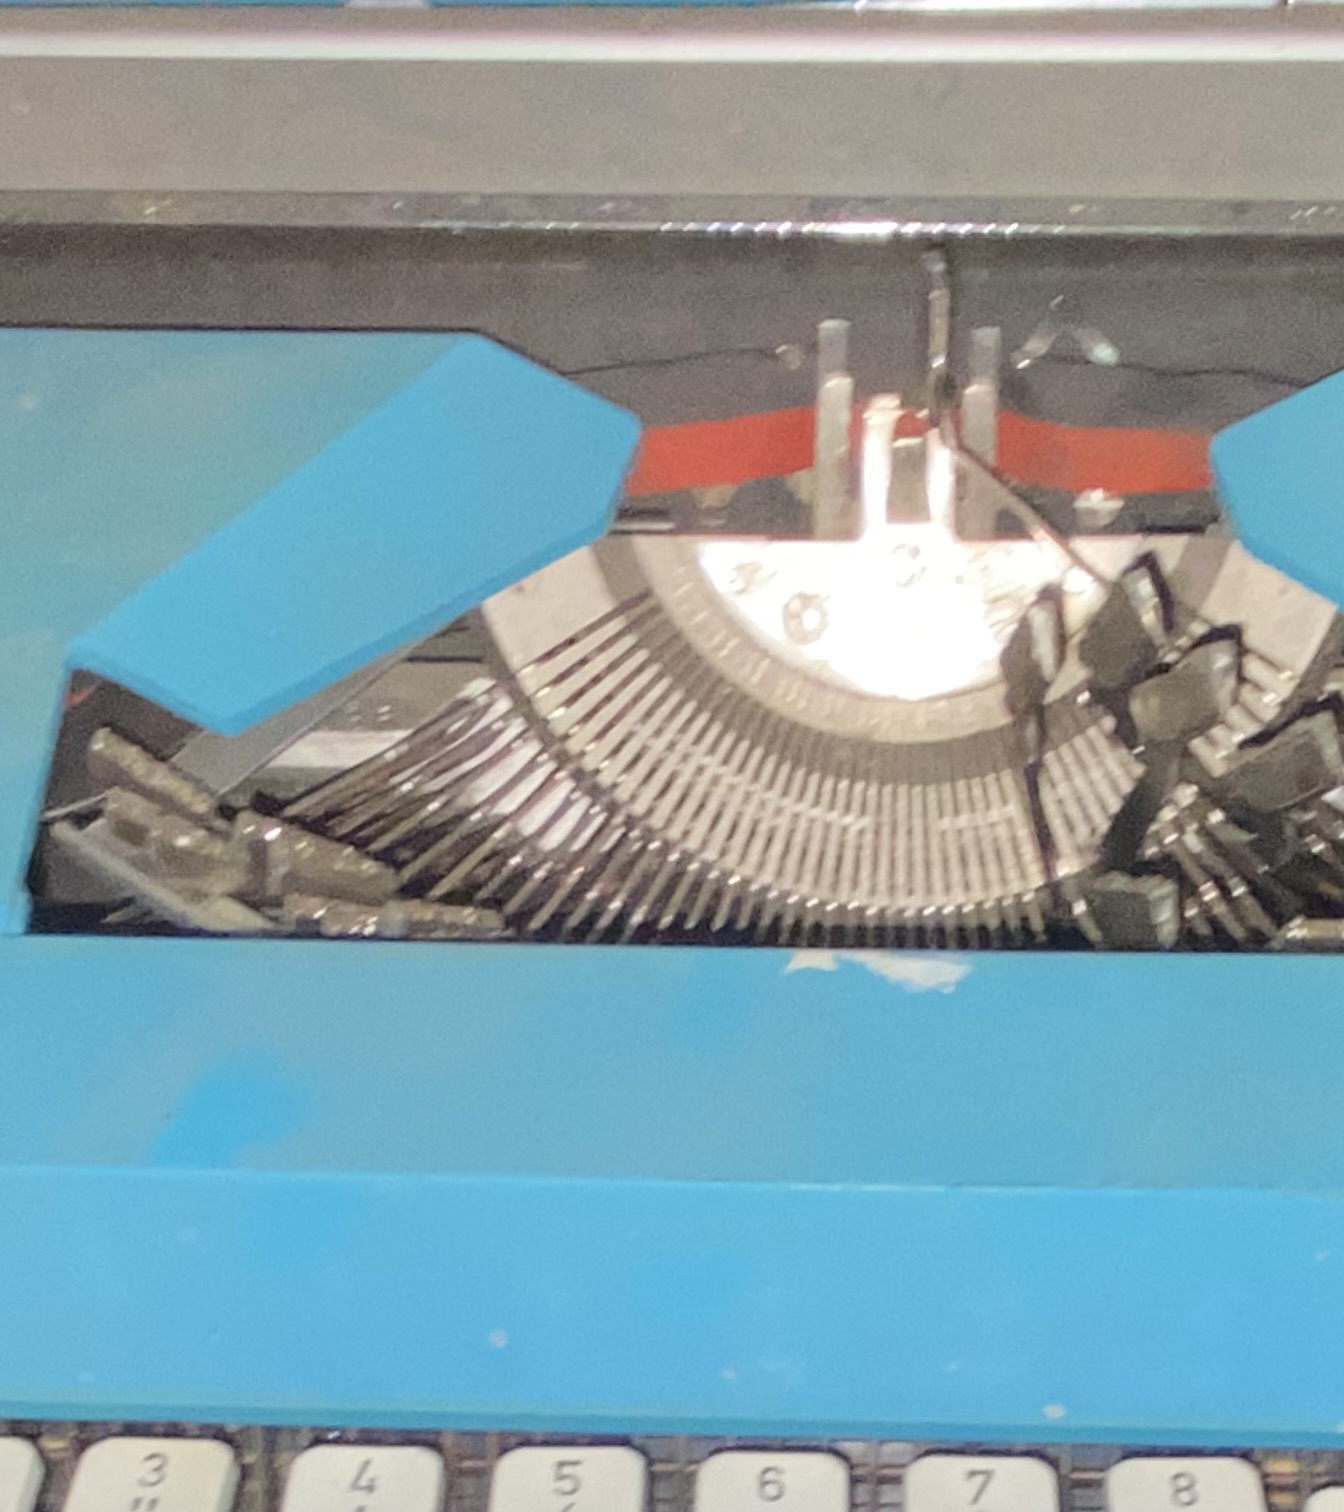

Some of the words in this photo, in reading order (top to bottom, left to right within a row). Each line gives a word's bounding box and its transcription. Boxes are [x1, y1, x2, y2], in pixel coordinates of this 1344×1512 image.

[139, 1451, 168, 1488] 3
[349, 1458, 377, 1495] 4
[554, 1459, 583, 1497] 5
[757, 1465, 785, 1503] 6
[965, 1468, 995, 1505] 7
[1170, 1471, 1199, 1508] 8
